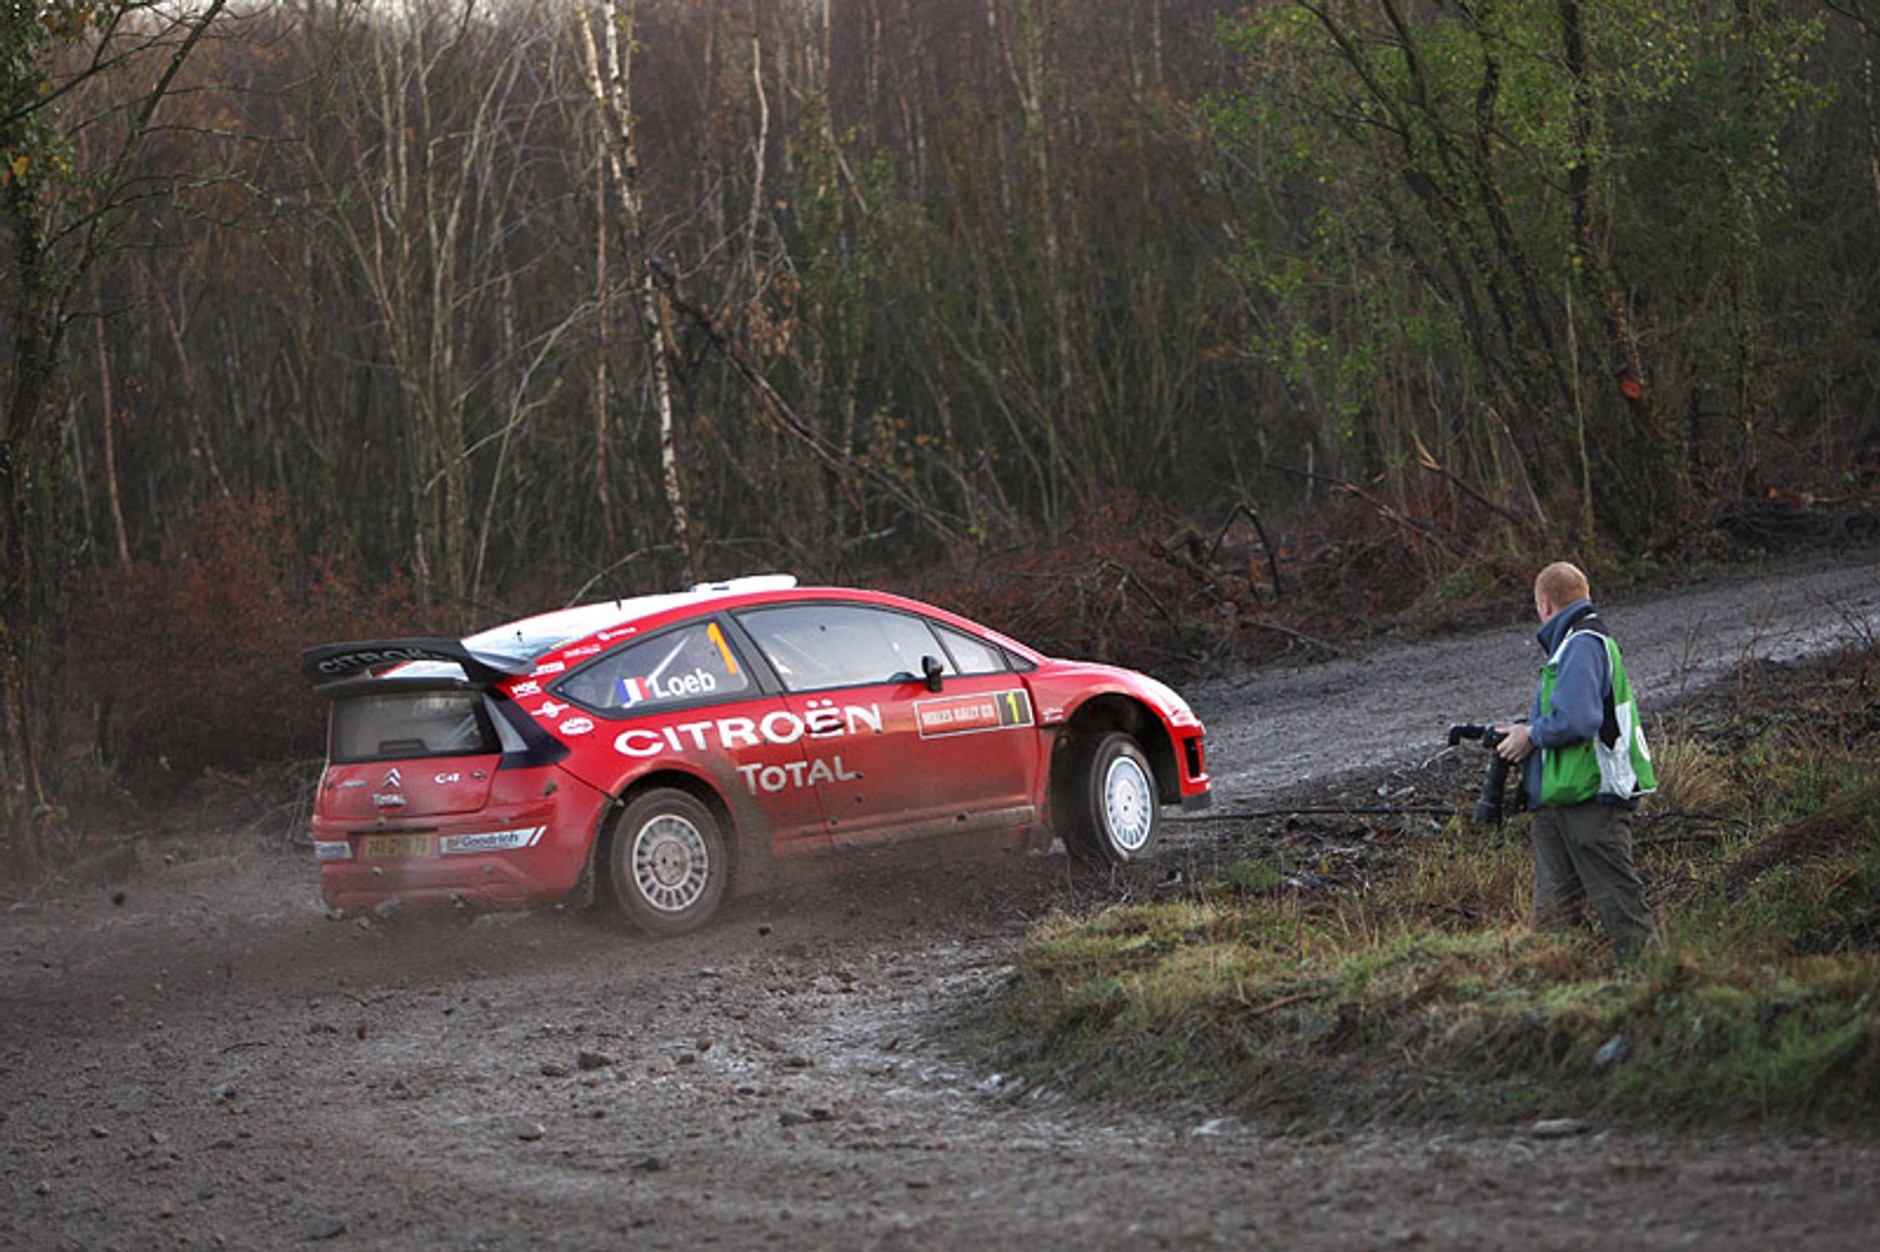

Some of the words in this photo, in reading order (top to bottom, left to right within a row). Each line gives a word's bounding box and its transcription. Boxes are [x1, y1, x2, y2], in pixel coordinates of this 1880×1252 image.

[706, 622, 737, 675] 1
[650, 667, 716, 698] Loeb
[1005, 690, 1020, 724] 1
[613, 699, 884, 757] CITROËN
[736, 755, 858, 795] TOTAL
